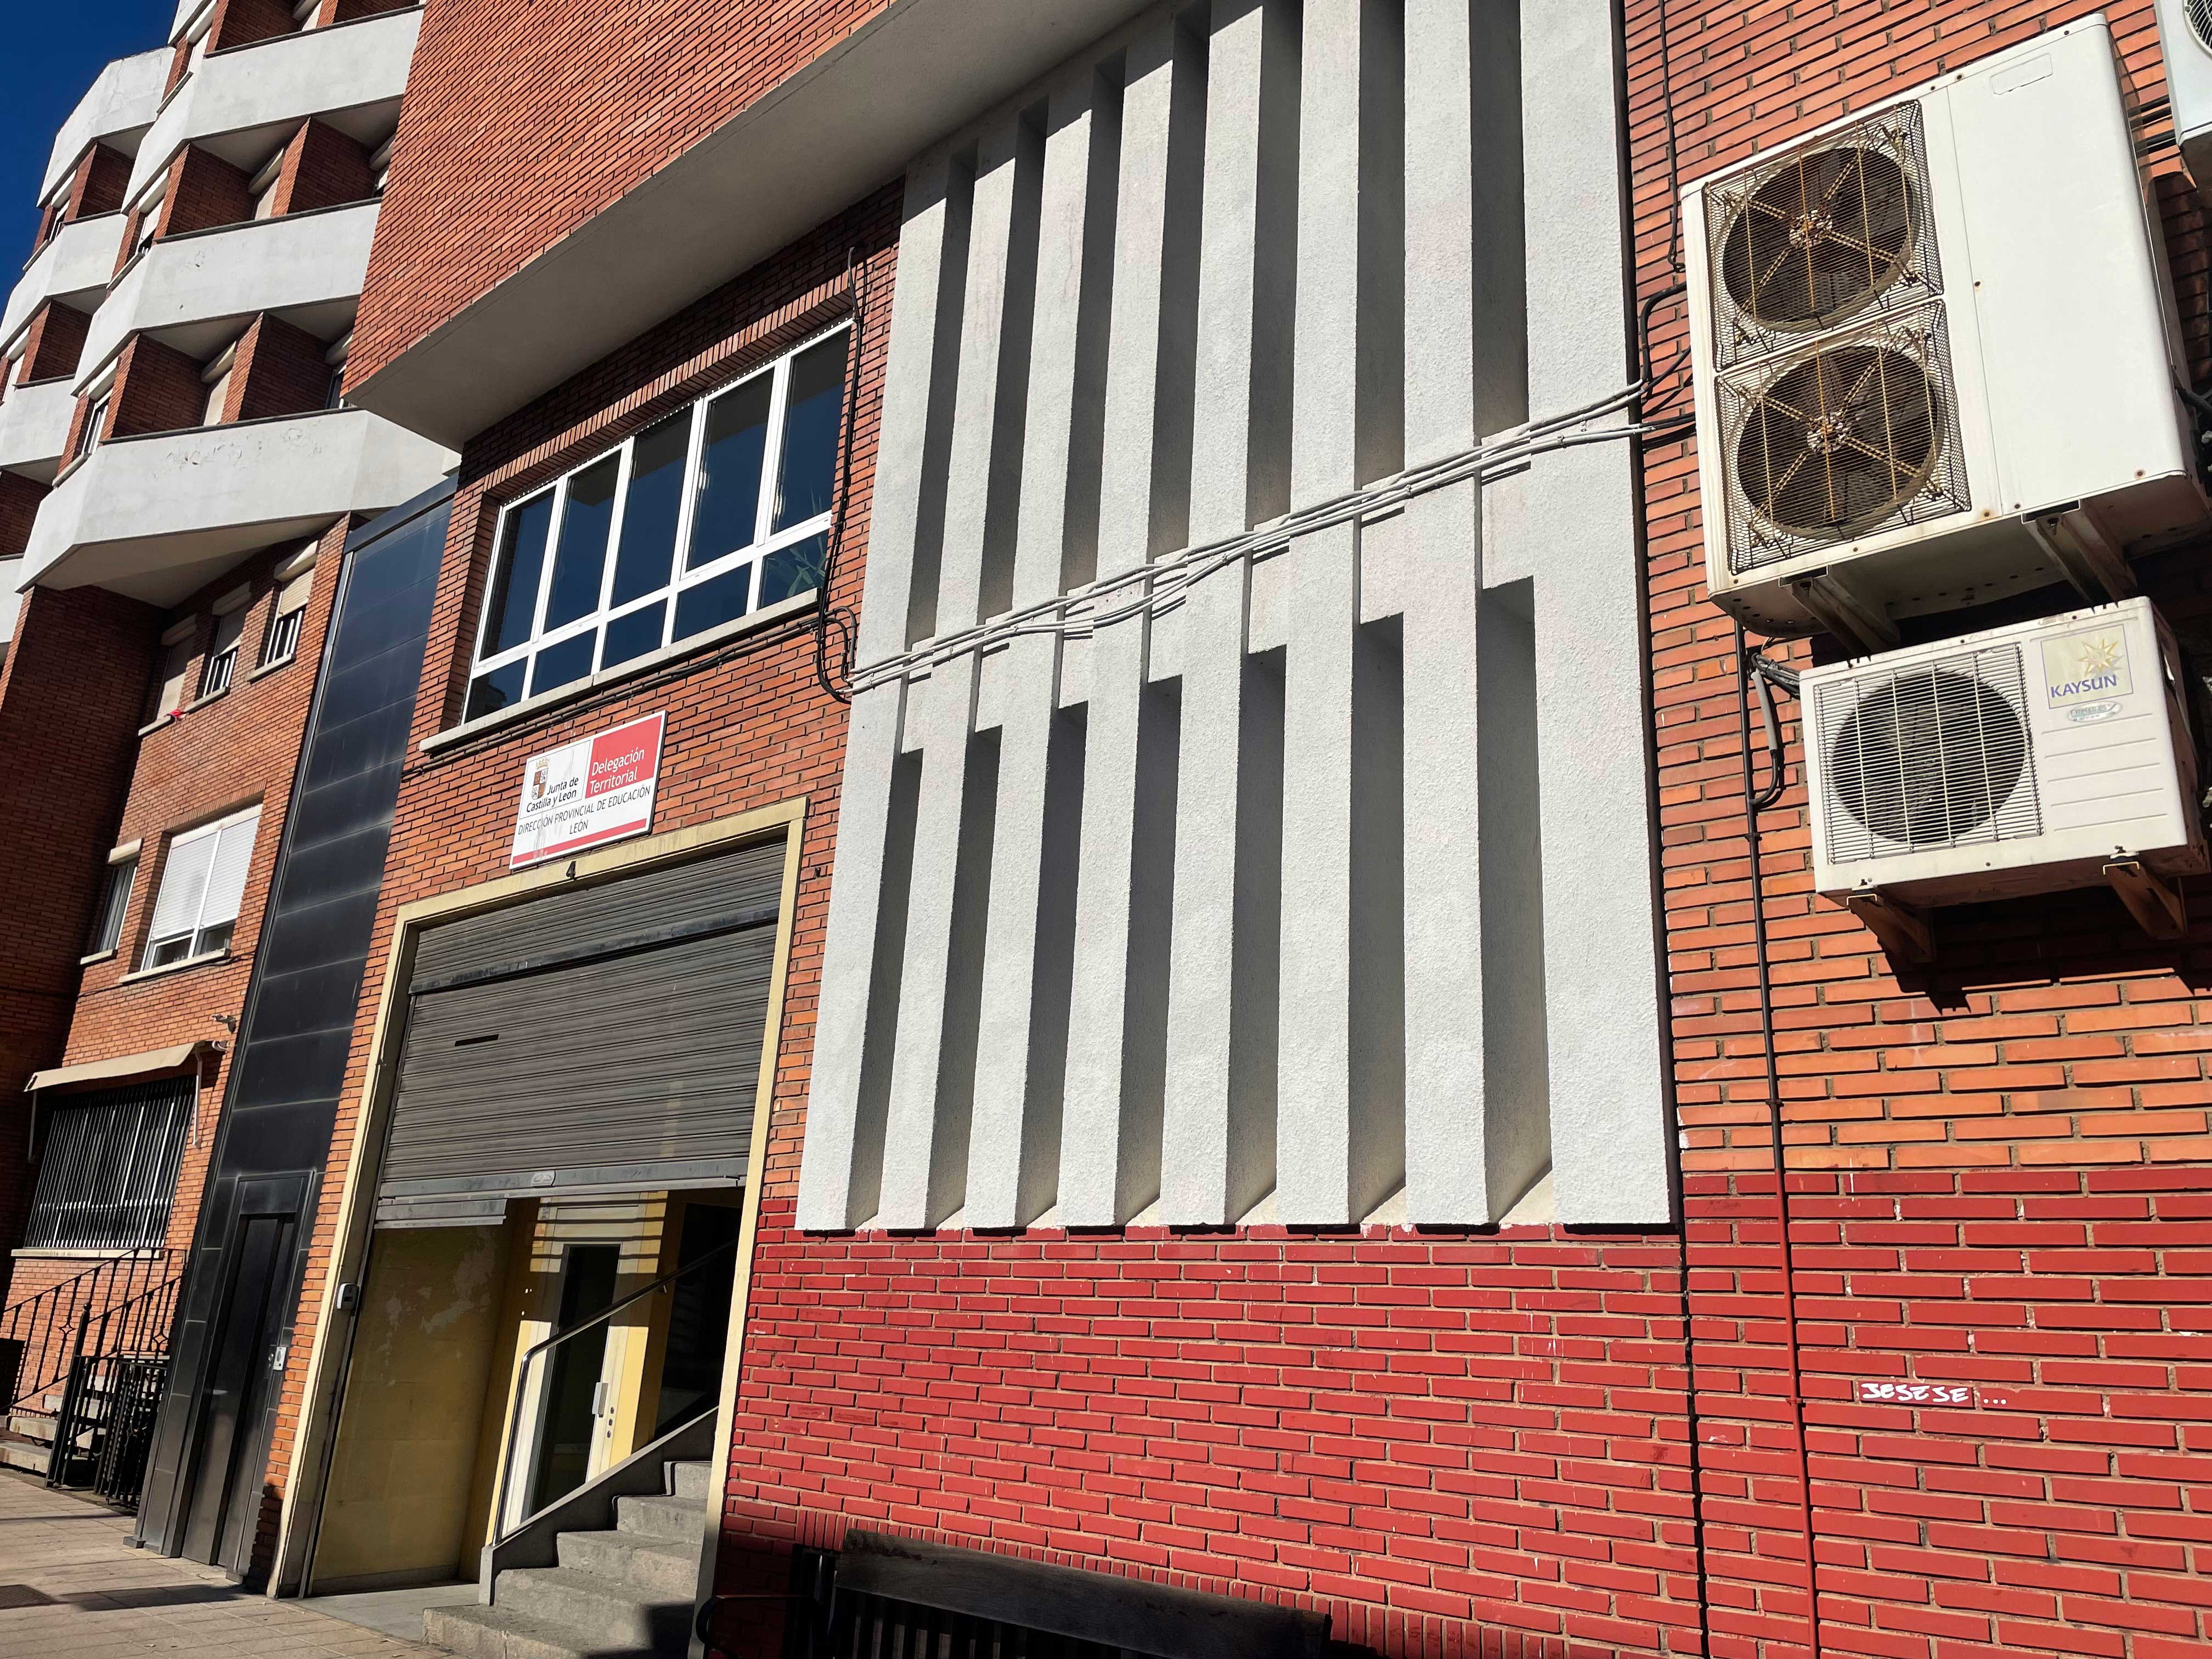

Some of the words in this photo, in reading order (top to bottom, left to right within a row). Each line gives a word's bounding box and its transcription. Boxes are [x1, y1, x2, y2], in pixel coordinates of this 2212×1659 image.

[2050, 674, 2118, 698] KAYSUN
[591, 747, 645, 776] Delegación
[547, 782, 567, 795] Junta
[569, 777, 579, 789] de
[590, 766, 637, 794] Territorial
[518, 814, 553, 835] DIRECCIÓN
[554, 803, 595, 823] PROVINCIAL
[596, 799, 607, 811] DE
[608, 785, 651, 807] EDUCACIÓN
[526, 796, 551, 812] Castilla
[552, 798, 556, 807] y
[558, 788, 577, 803] León
[569, 820, 589, 834] LEÓN
